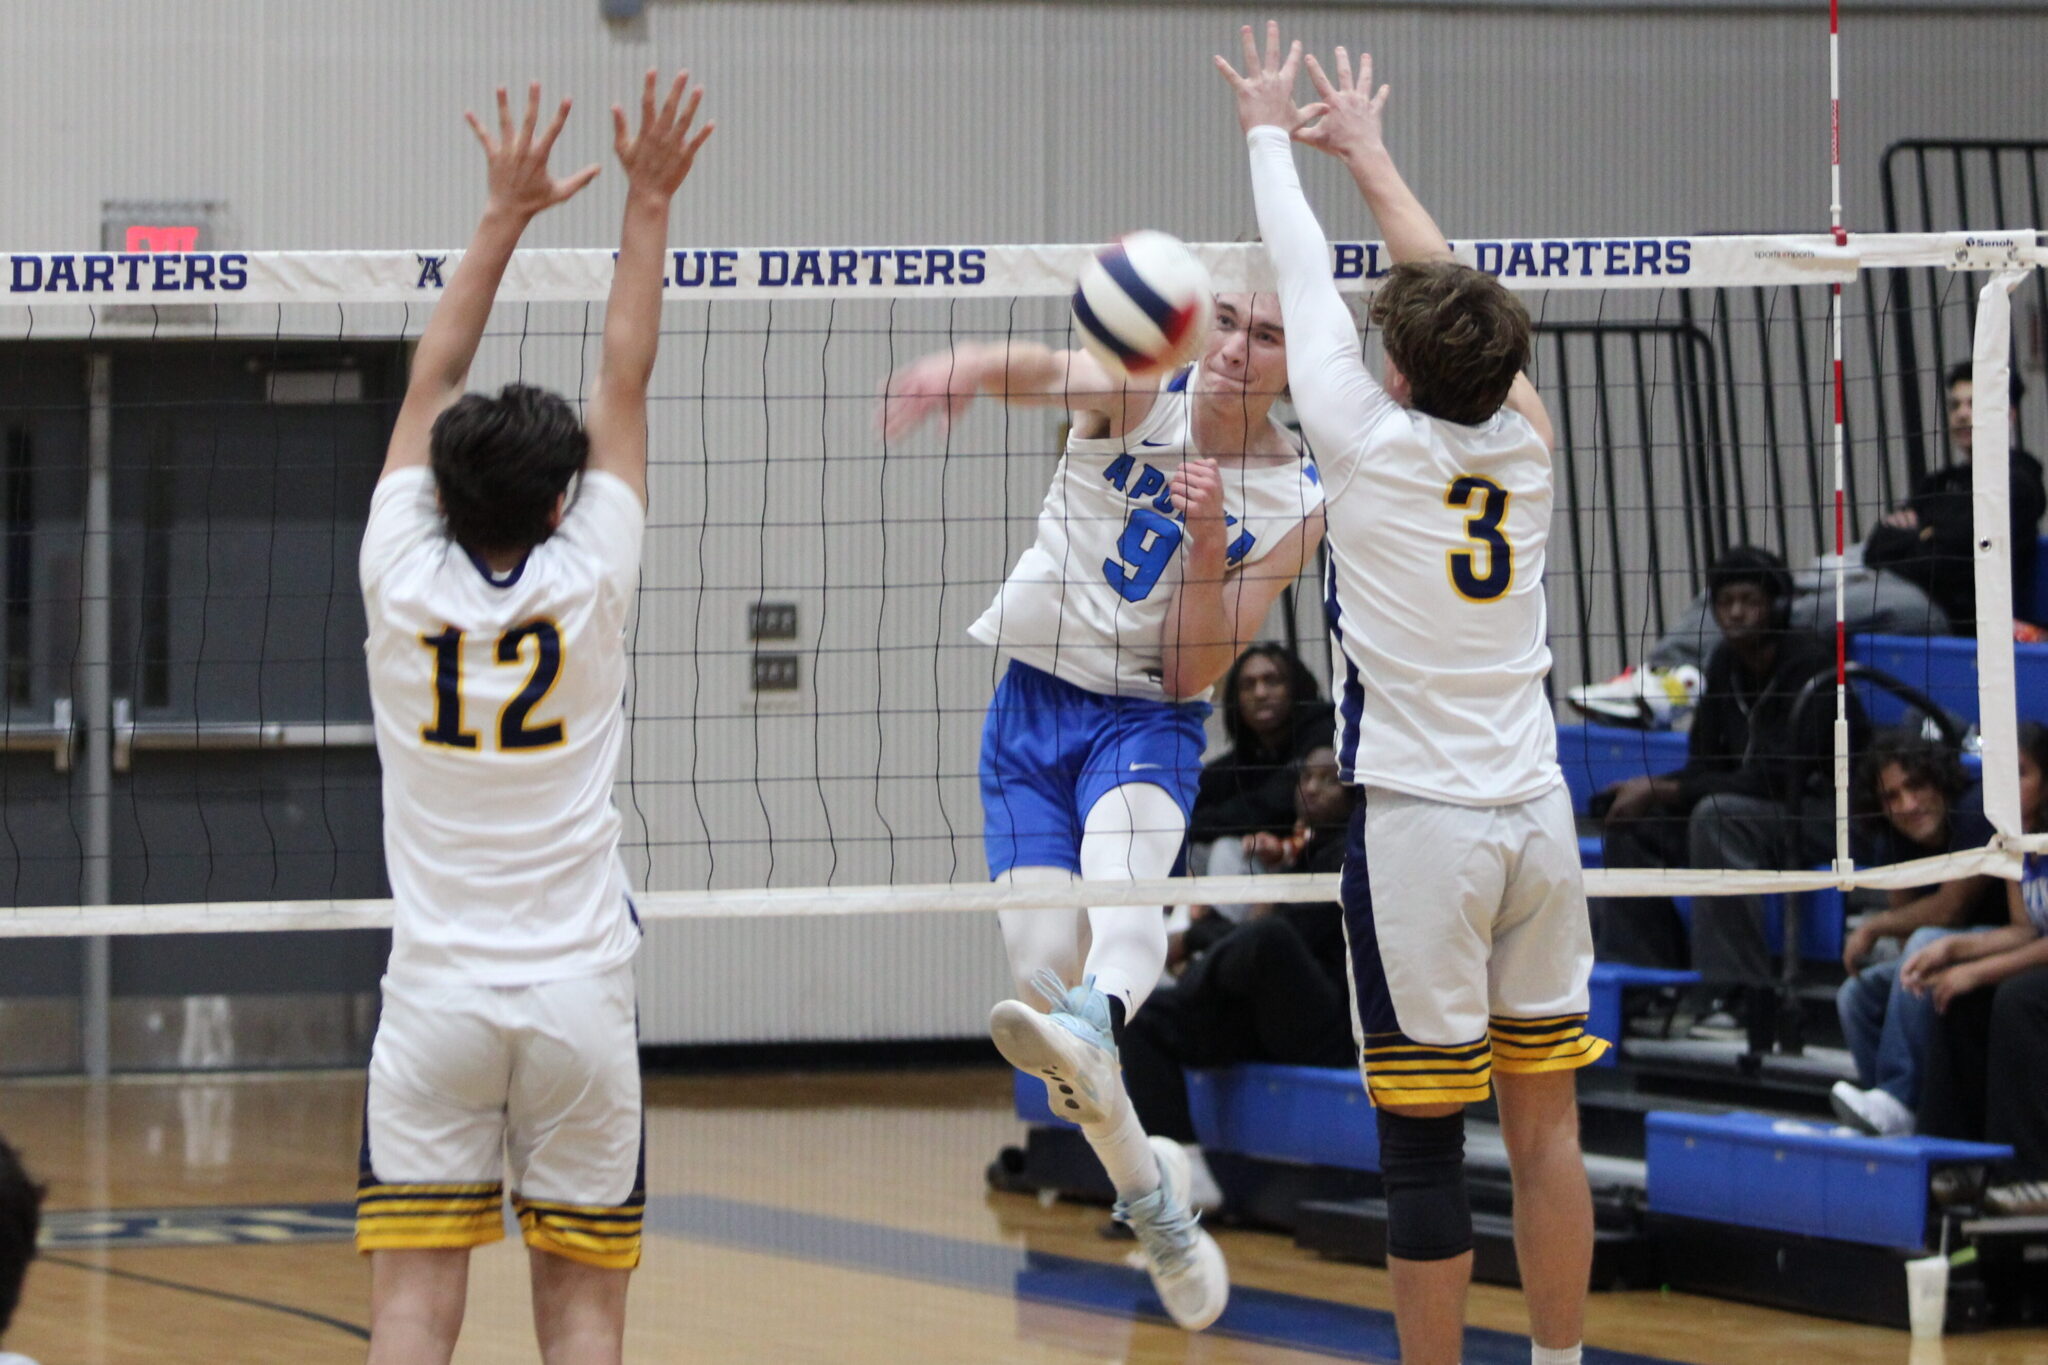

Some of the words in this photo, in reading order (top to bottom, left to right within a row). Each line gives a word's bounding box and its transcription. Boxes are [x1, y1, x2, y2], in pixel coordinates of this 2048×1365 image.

[1474, 240, 1691, 277] DARTERS
[1977, 238, 2013, 247] Senoh
[10, 254, 248, 293] DARTERS
[612, 250, 738, 287] UE
[758, 249, 986, 287] DARTERS
[1102, 508, 1182, 604] 9
[1443, 473, 1515, 605] 3
[417, 614, 568, 754] 12
